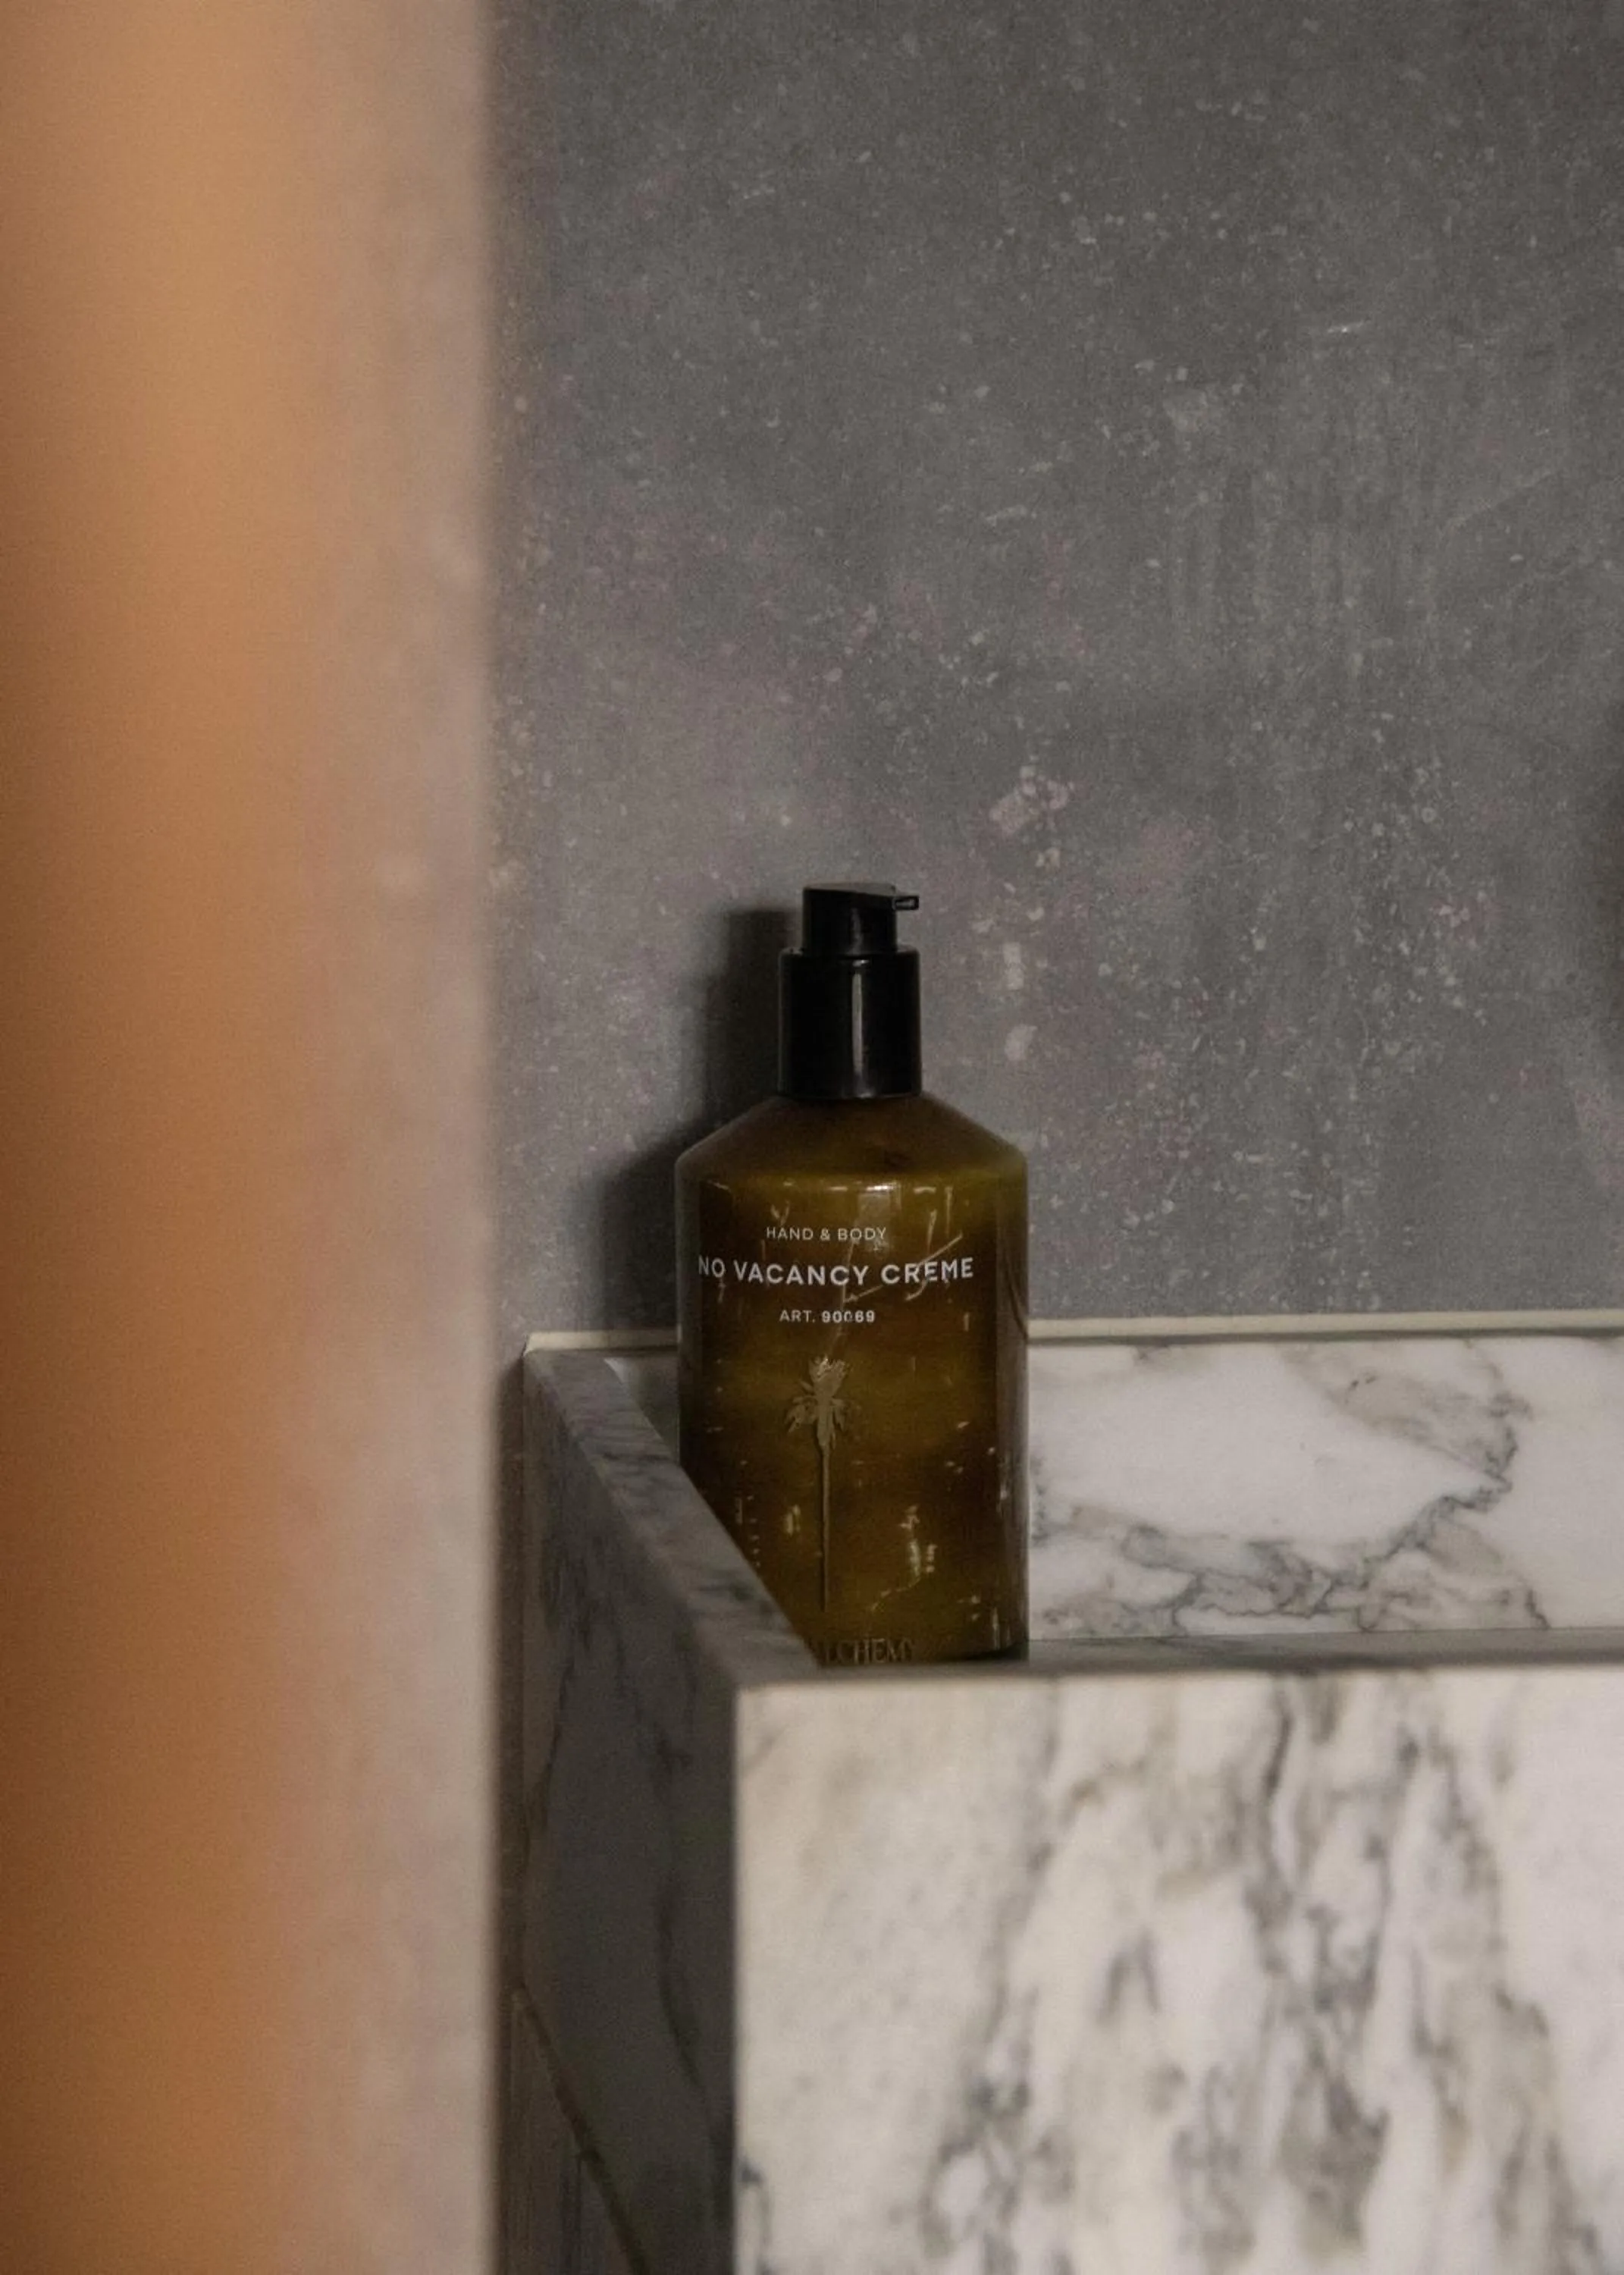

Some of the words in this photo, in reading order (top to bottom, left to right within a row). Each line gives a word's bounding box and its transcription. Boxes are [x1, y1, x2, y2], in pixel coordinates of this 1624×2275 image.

[766, 1226, 814, 1241] HAND
[820, 1227, 831, 1241] &
[837, 1226, 887, 1241] BODY
[698, 1255, 726, 1279] NO
[733, 1260, 870, 1286] VACANCY
[880, 1257, 974, 1285] CREME
[779, 1310, 817, 1324] ART.
